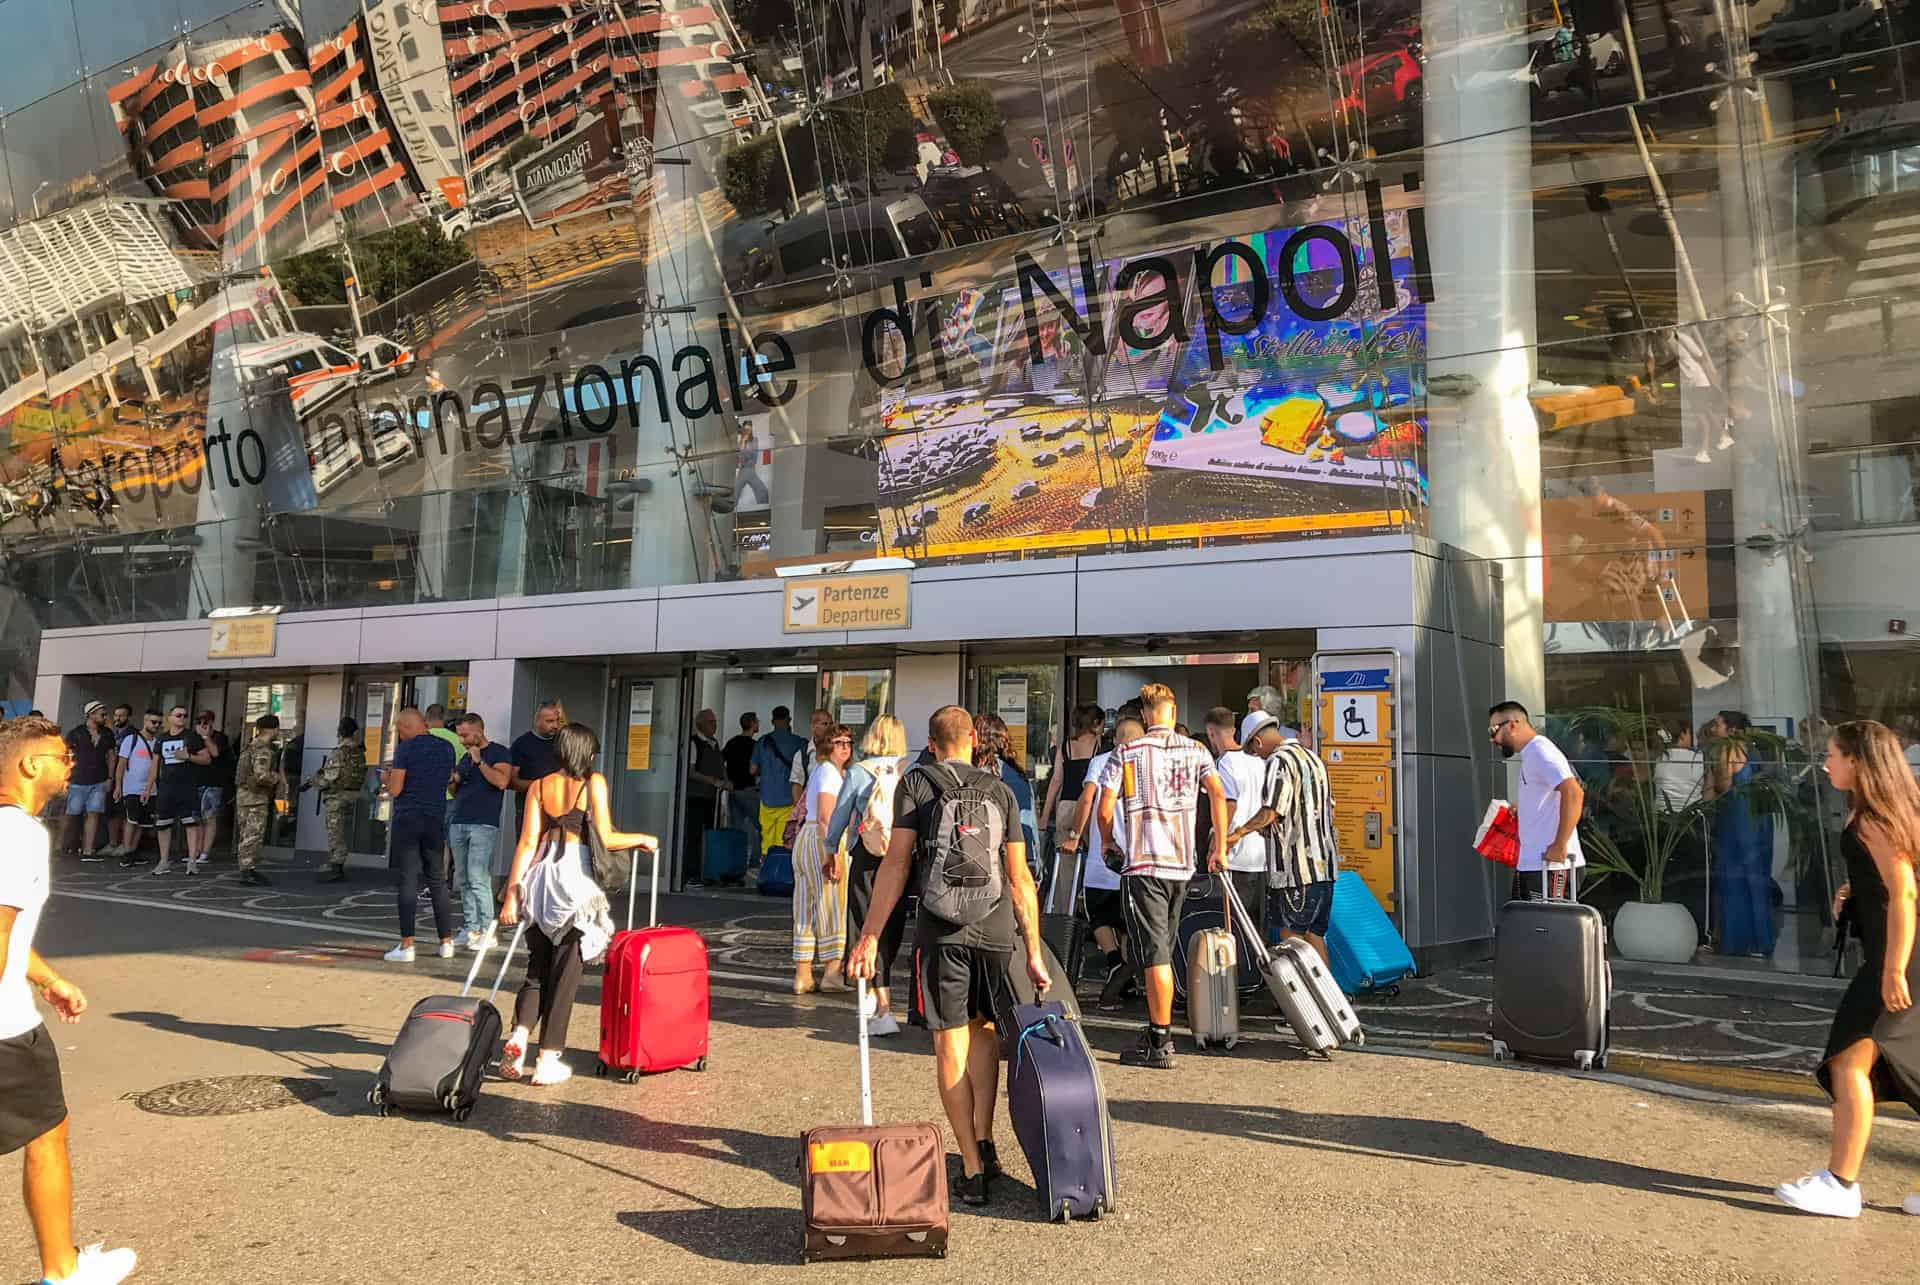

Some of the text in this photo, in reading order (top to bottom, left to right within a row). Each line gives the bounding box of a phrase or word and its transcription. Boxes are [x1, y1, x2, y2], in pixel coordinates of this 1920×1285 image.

[861, 271, 944, 393] di
[1013, 172, 1435, 371] Napoli
[823, 585, 889, 603] Partenze
[823, 607, 902, 626] Departures
